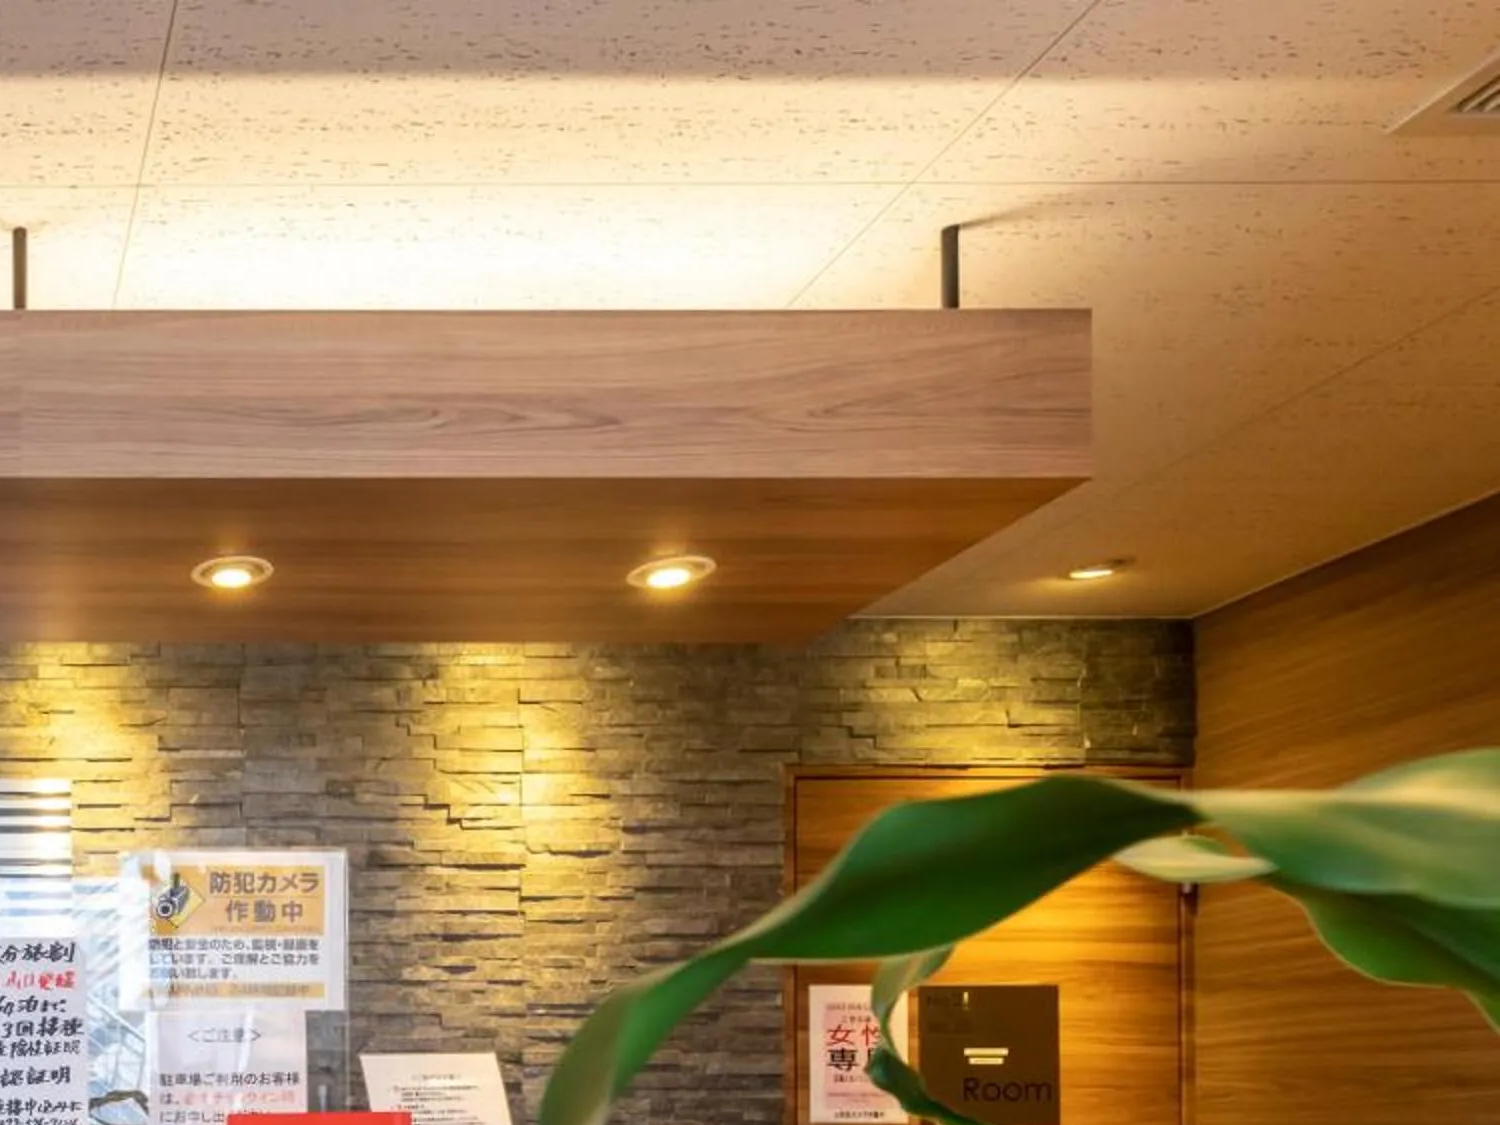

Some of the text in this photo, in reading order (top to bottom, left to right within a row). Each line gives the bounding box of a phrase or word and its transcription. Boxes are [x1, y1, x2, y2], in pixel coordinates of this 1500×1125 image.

[209, 872, 319, 894] 防犯カメラ
[225, 900, 304, 922] 作動中
[159, 1071, 301, 1088] 駐車場ご利用のお客様
[963, 1077, 1052, 1102] Room
